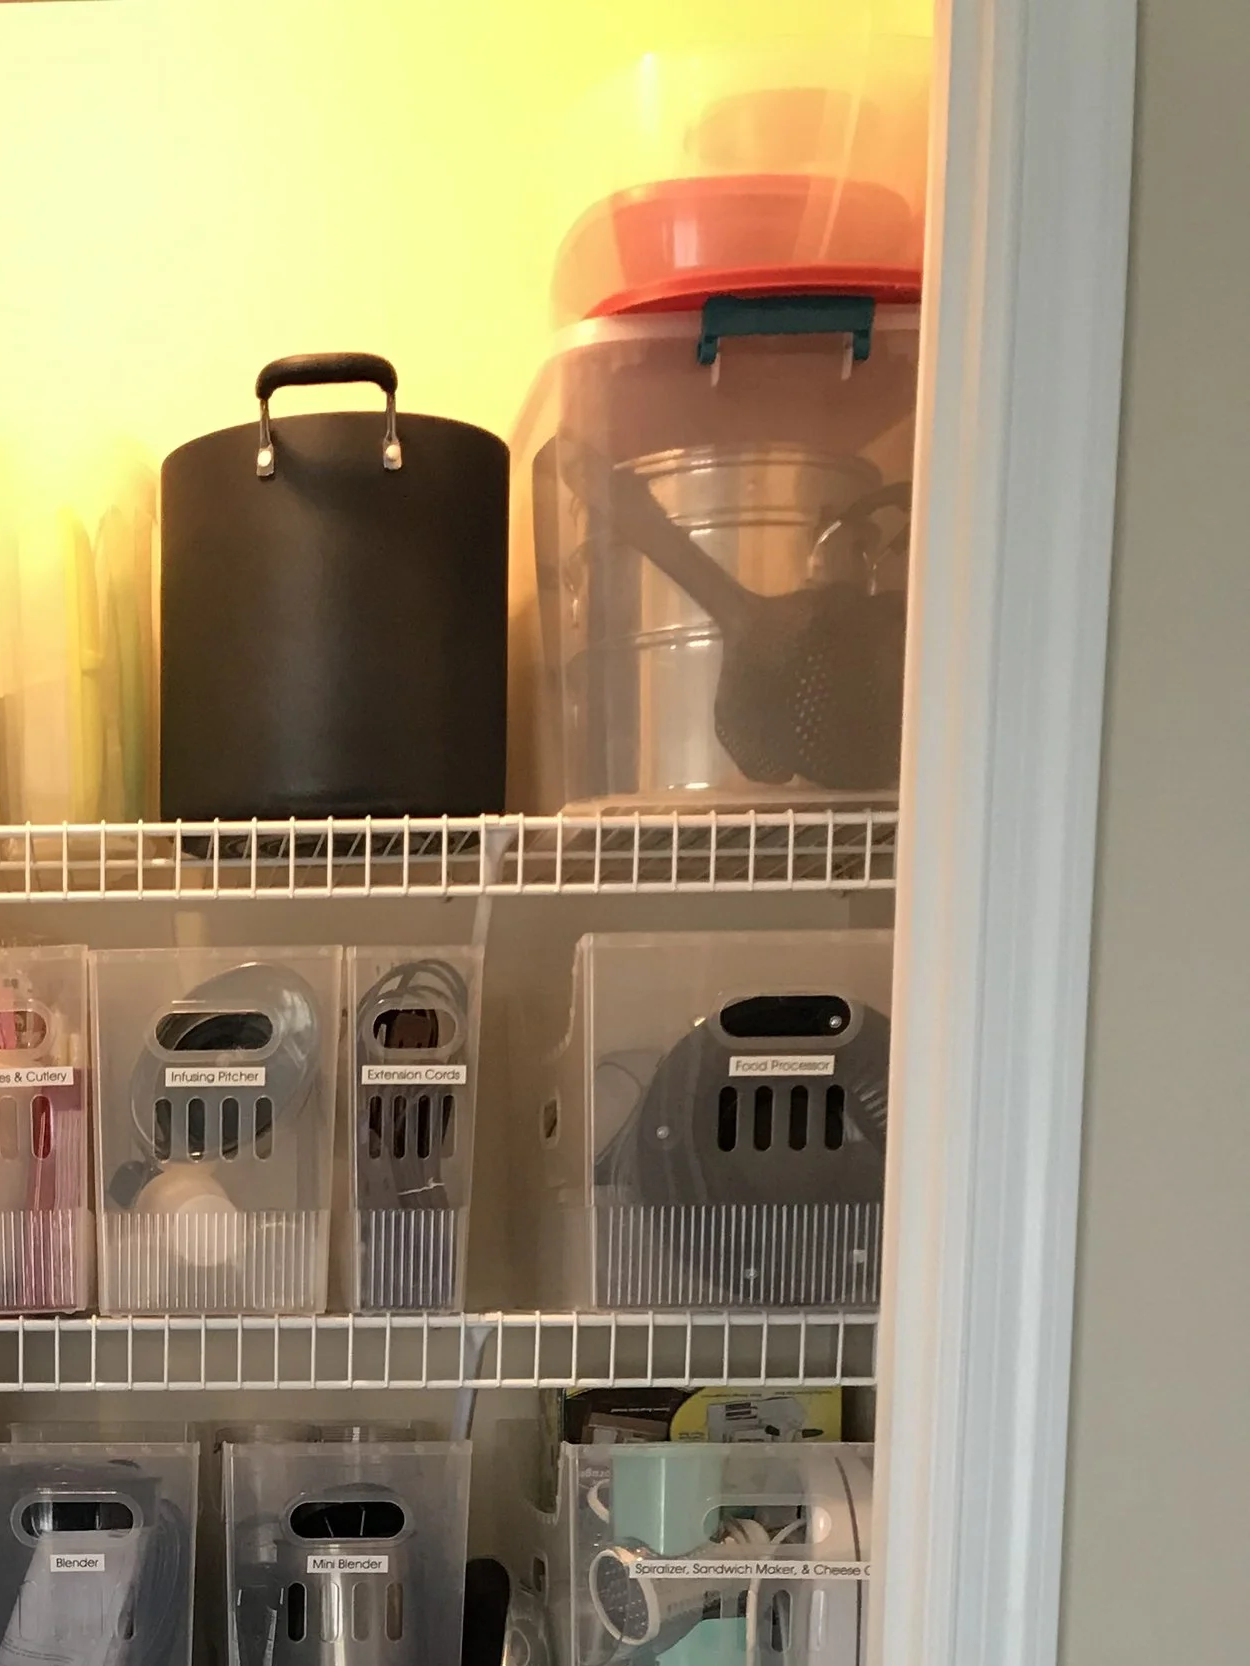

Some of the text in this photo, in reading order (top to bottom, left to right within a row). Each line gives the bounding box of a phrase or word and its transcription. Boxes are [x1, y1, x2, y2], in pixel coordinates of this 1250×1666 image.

[735, 1060, 830, 1072] Food Processor
[14, 1072, 22, 1082] &
[26, 1071, 67, 1083] Cutlery
[171, 1071, 259, 1083] Infusing Pitcher
[367, 1068, 460, 1080] Extension Cords
[56, 1557, 99, 1568] Blender
[313, 1559, 382, 1569] Mini Blender
[635, 1563, 690, 1576] Spiralizer,
[692, 1563, 753, 1575] Sandwich
[755, 1563, 797, 1576] Maker,
[801, 1564, 810, 1575] &
[814, 1564, 861, 1576] Cheese
